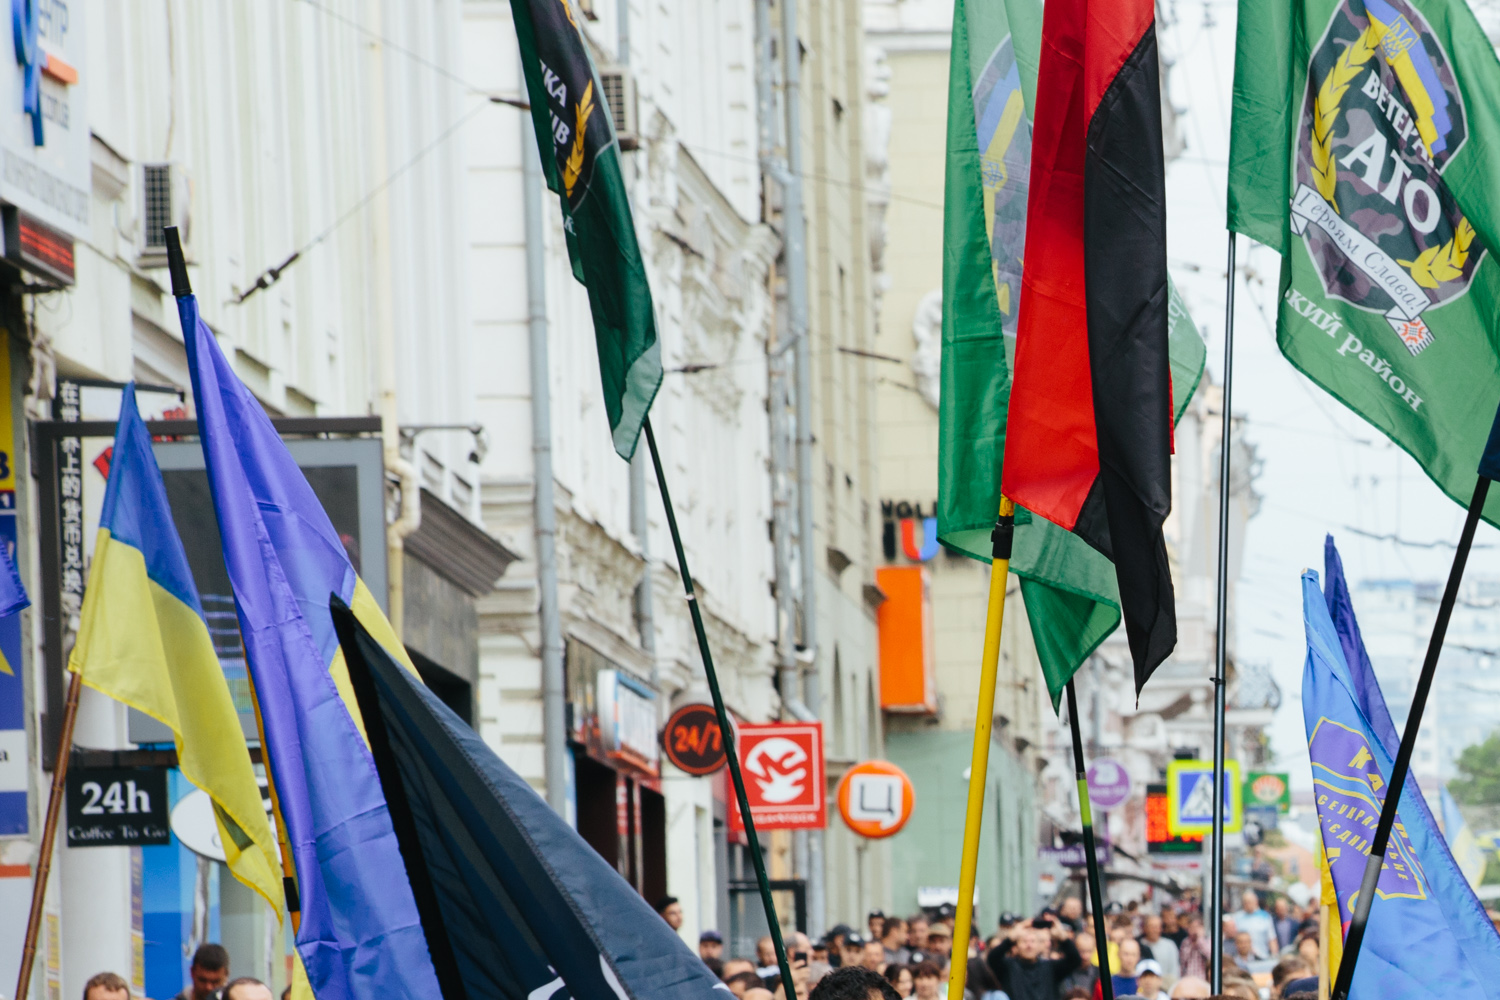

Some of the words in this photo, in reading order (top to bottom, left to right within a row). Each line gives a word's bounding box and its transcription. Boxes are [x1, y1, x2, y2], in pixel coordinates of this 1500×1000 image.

[1336, 332, 1424, 412] район
[674, 720, 721, 757] 24/7
[81, 780, 152, 815] 24h
[68, 826, 114, 840] Coffee
[121, 825, 138, 839] To
[143, 825, 167, 839] Go
